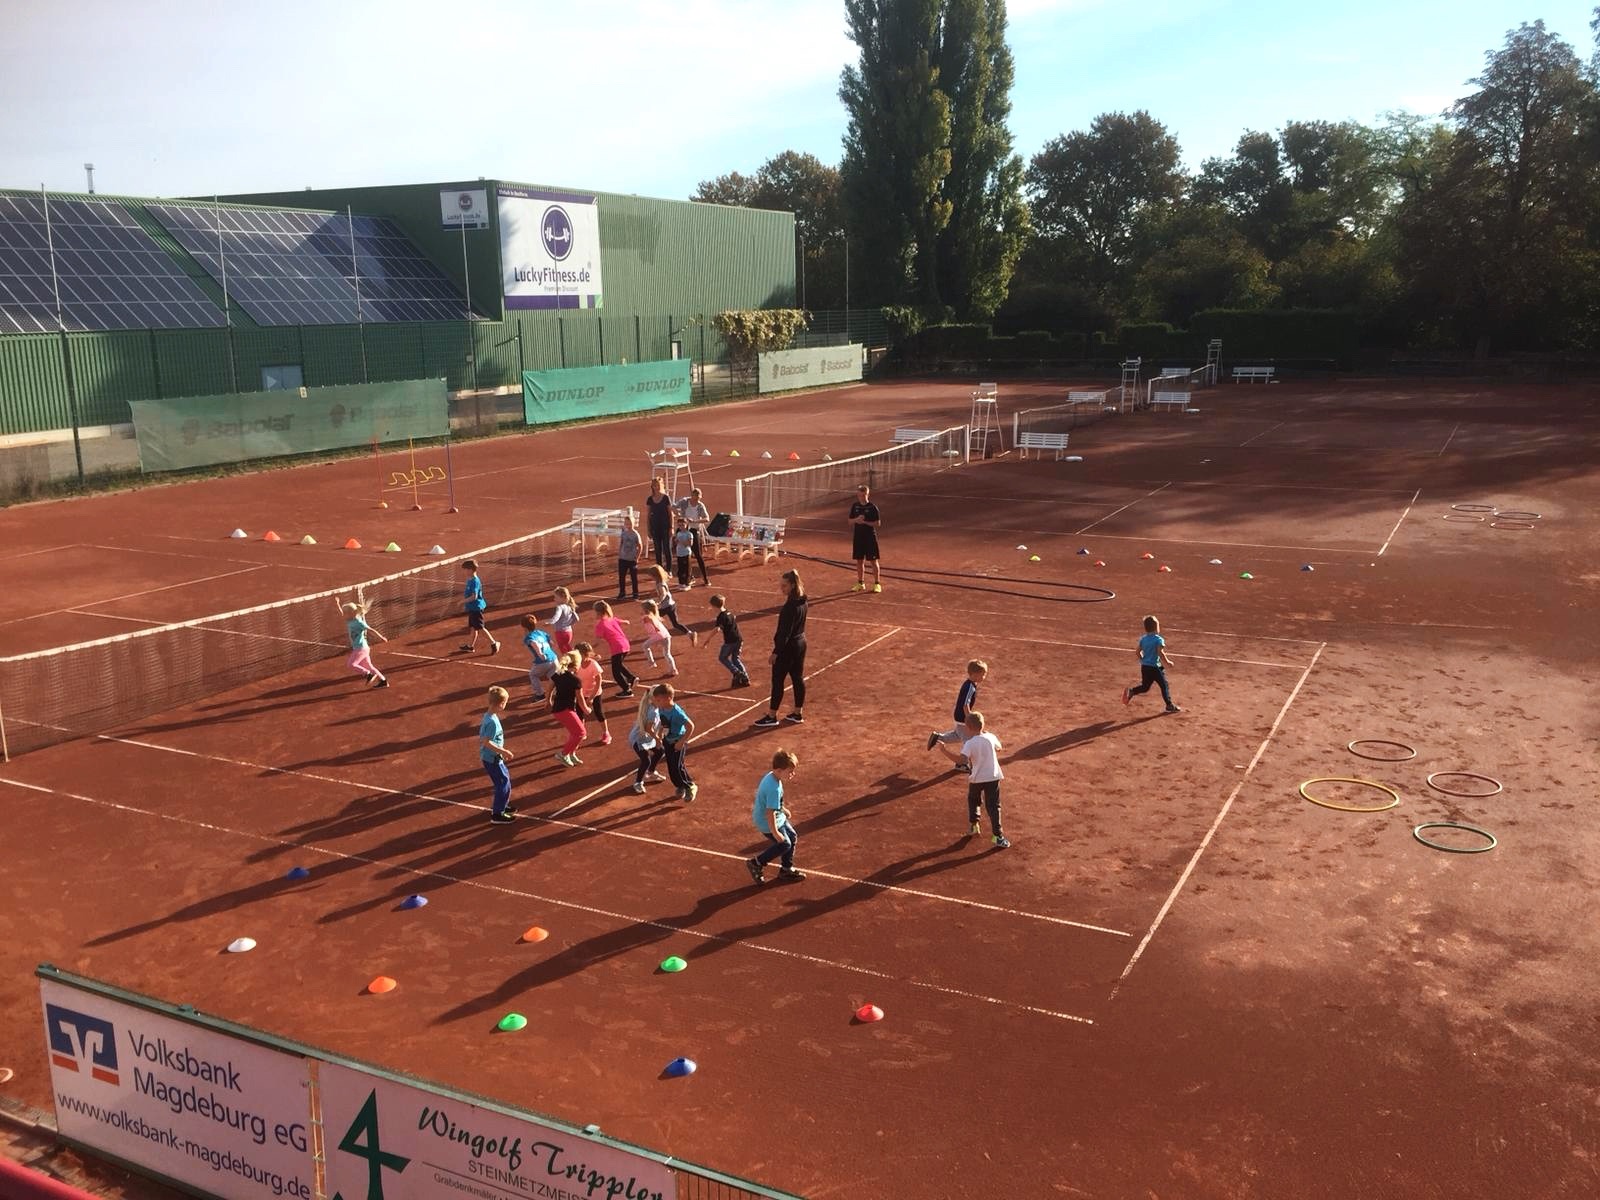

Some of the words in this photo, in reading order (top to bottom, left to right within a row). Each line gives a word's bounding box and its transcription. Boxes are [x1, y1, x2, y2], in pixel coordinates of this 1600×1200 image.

[514, 266, 590, 286] LuckyFitness.de
[546, 386, 605, 401] DUNLOP
[635, 377, 685, 393] DUNLOP
[128, 1029, 242, 1093] Volksbank
[133, 1066, 266, 1145] Magdeburg
[274, 1122, 307, 1153] eG
[57, 1092, 311, 1199] www.volksbank-magdeburg.de
[418, 1106, 522, 1171] Wingolf
[531, 1141, 663, 1200] Trippler
[468, 1159, 590, 1200] STEINMETZMEIS
